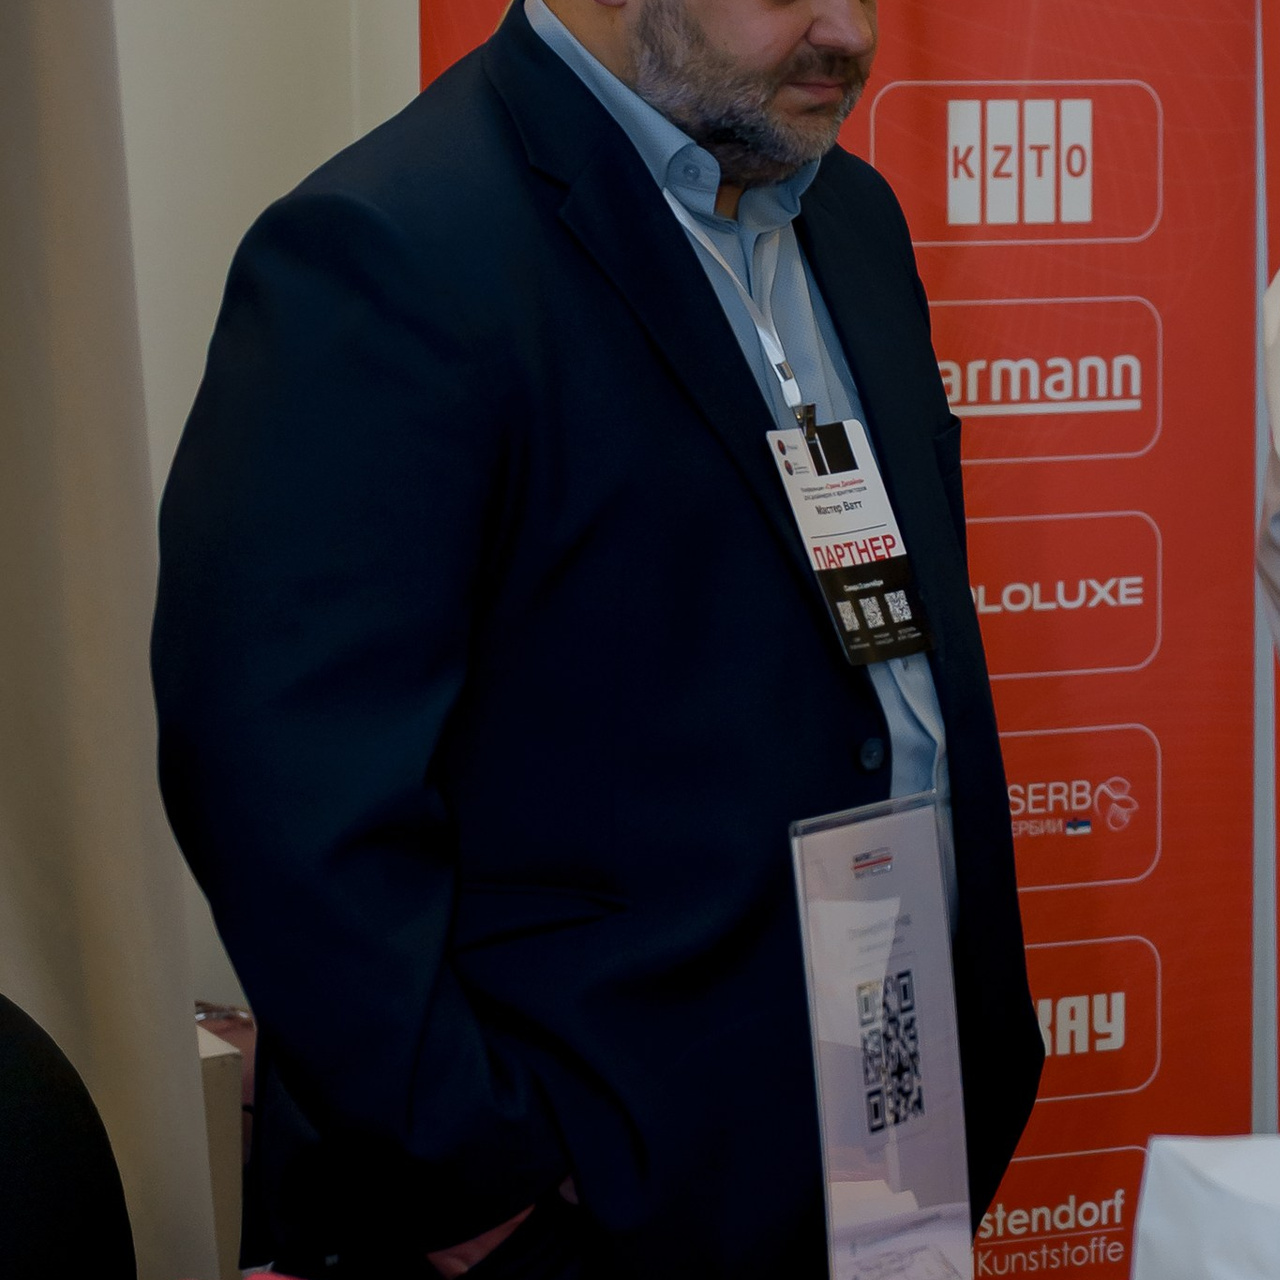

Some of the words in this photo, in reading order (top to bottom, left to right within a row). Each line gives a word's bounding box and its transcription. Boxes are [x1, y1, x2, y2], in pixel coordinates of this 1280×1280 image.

[952, 143, 1087, 181] KZTO
[812, 534, 896, 570] ПАРТНЕР
[970, 576, 1144, 614] LOLUXE
[976, 1236, 1126, 1278] Kunststoffe
